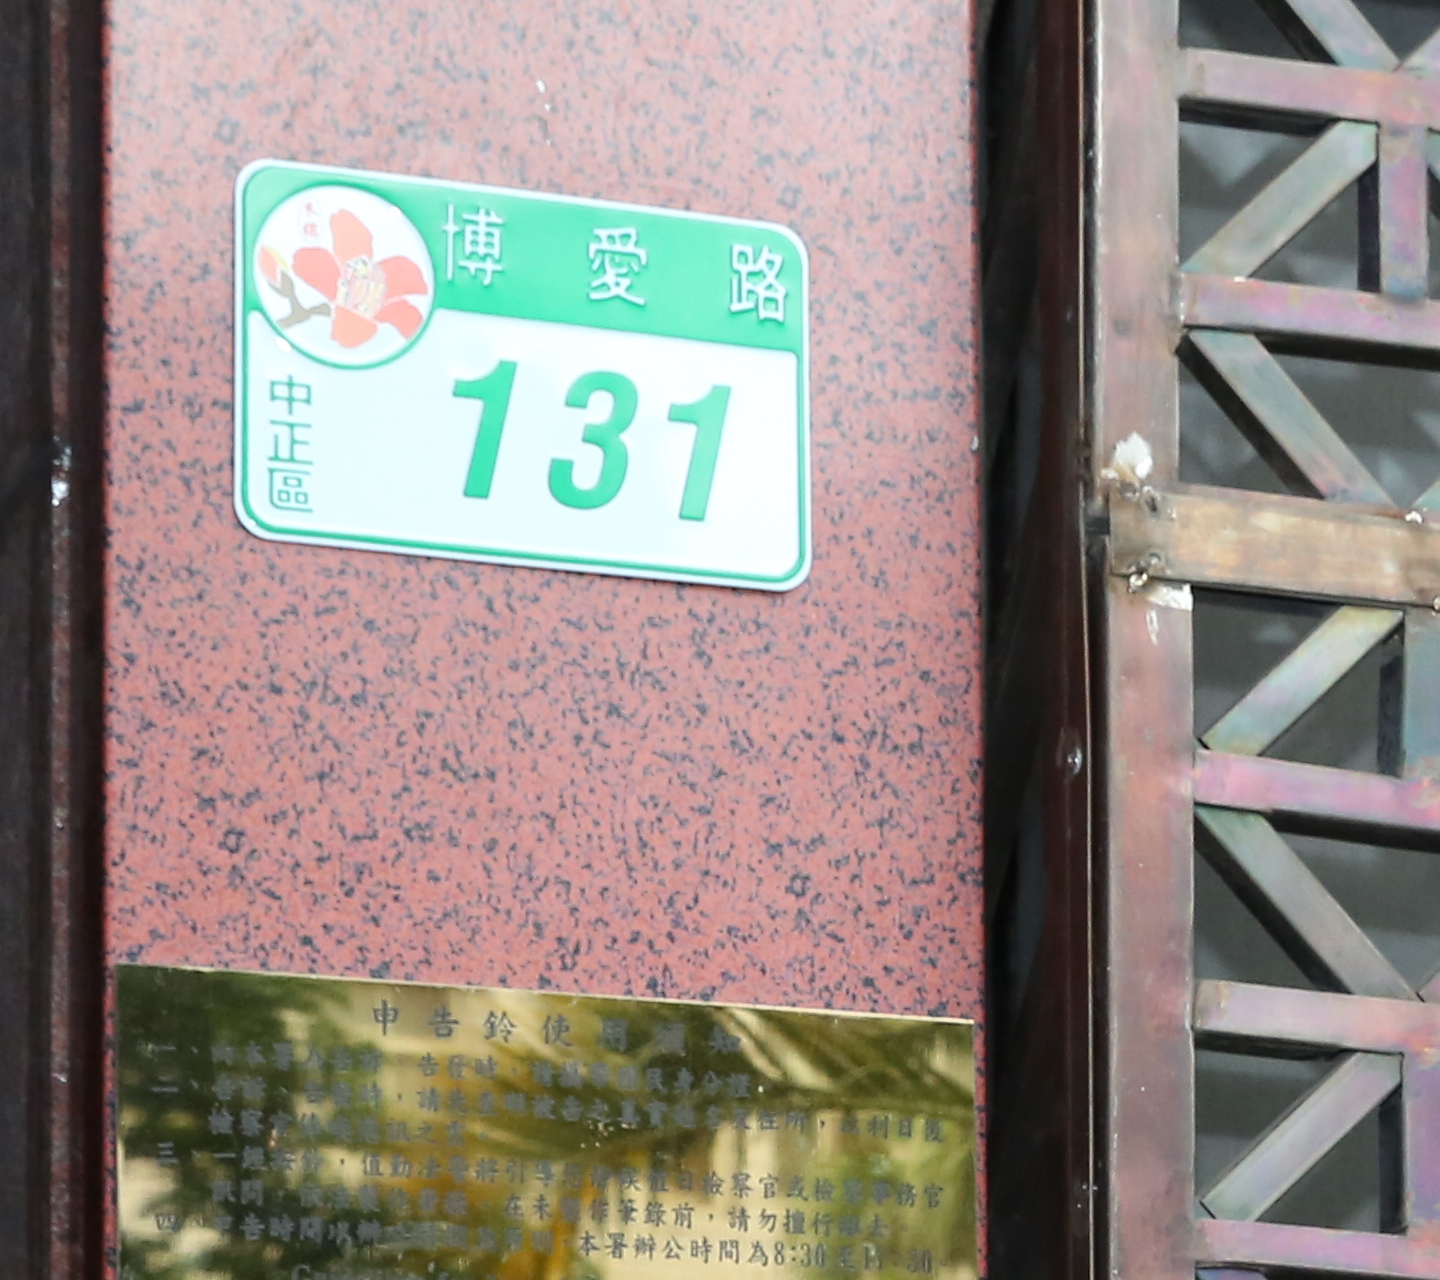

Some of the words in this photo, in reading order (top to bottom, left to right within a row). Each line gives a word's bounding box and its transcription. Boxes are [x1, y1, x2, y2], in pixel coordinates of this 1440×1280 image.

[441, 203, 789, 324] 博愛路
[265, 374, 314, 513] 中正區
[452, 359, 732, 522] 131
